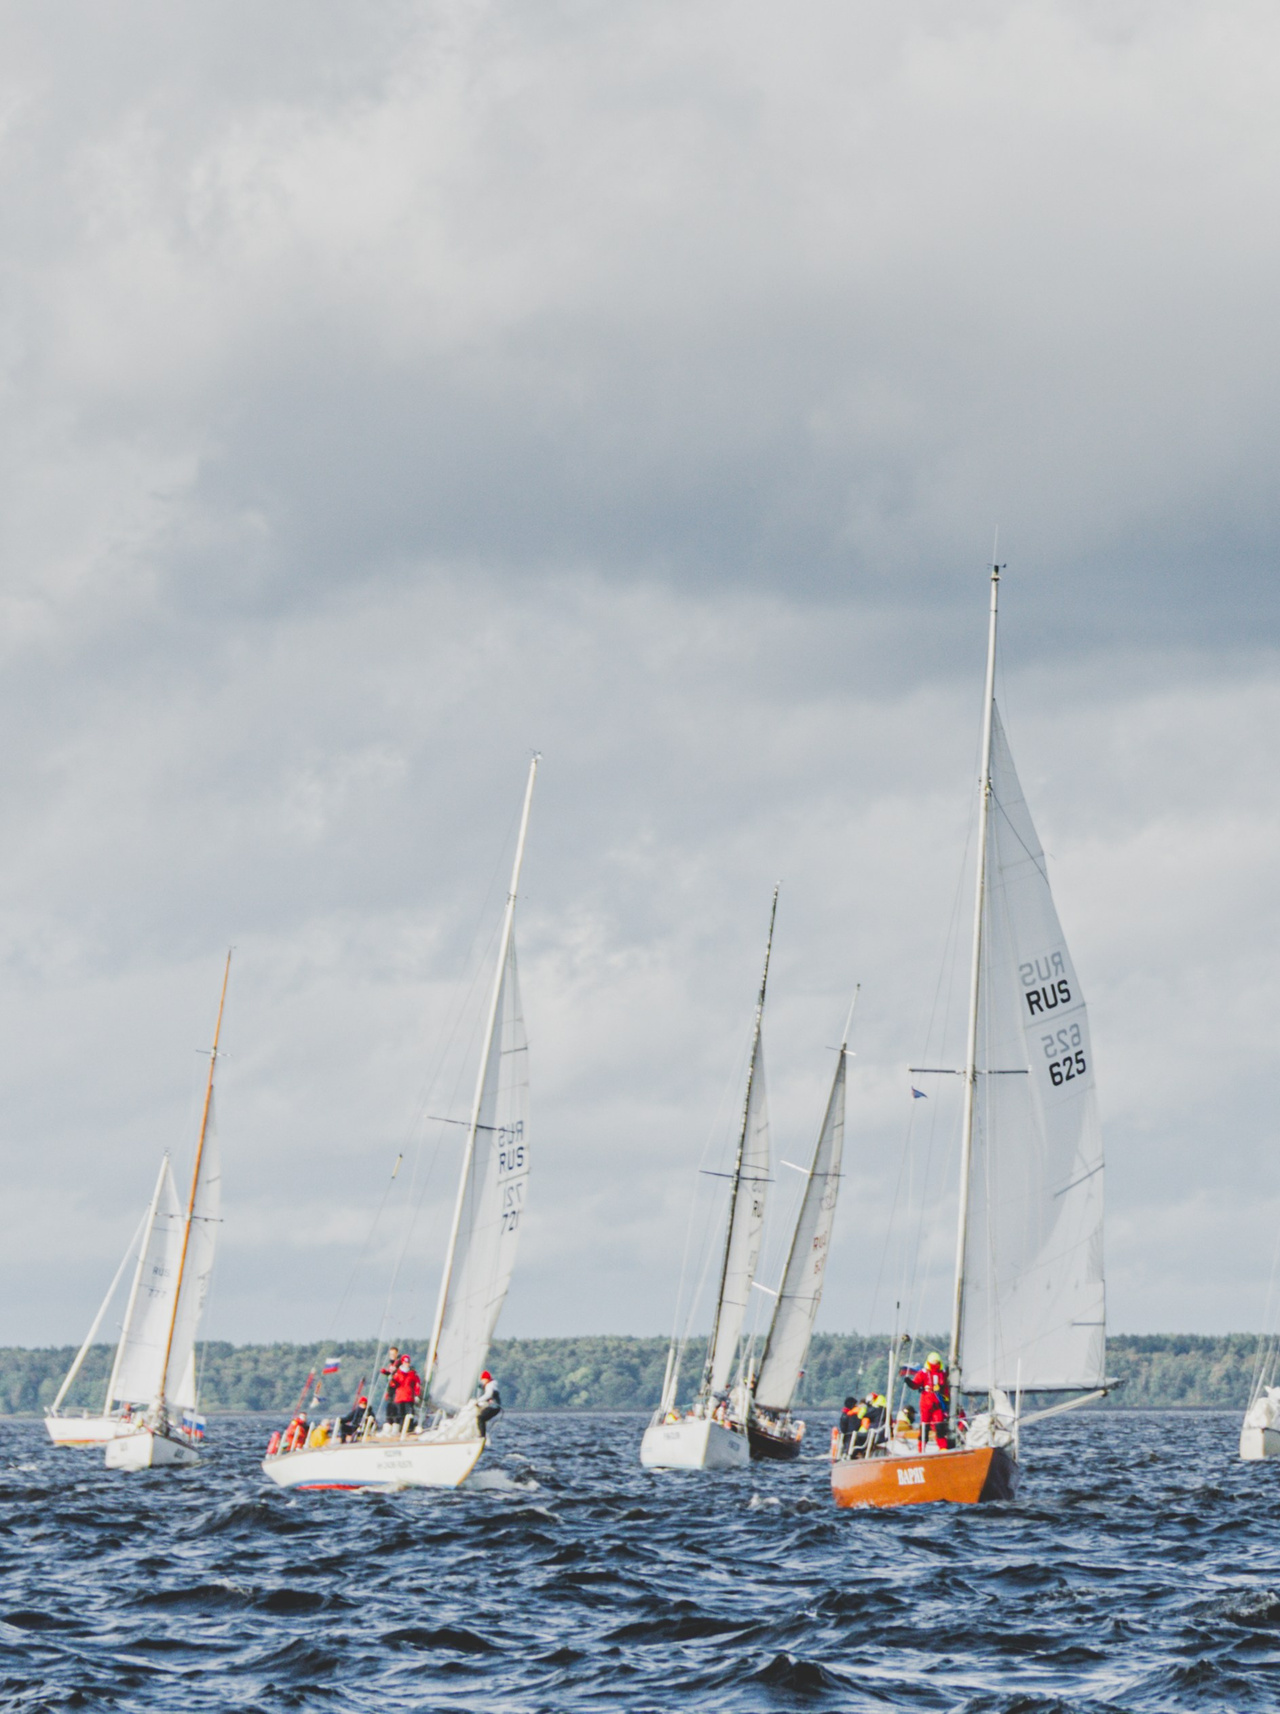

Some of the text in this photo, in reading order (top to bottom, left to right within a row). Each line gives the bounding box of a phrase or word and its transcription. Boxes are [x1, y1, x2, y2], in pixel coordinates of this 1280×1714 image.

[1025, 979, 1071, 1016] RUS
[1048, 1050, 1087, 1087] 625
[499, 1146, 525, 1174] RUS
[152, 1265, 171, 1278] RUS
